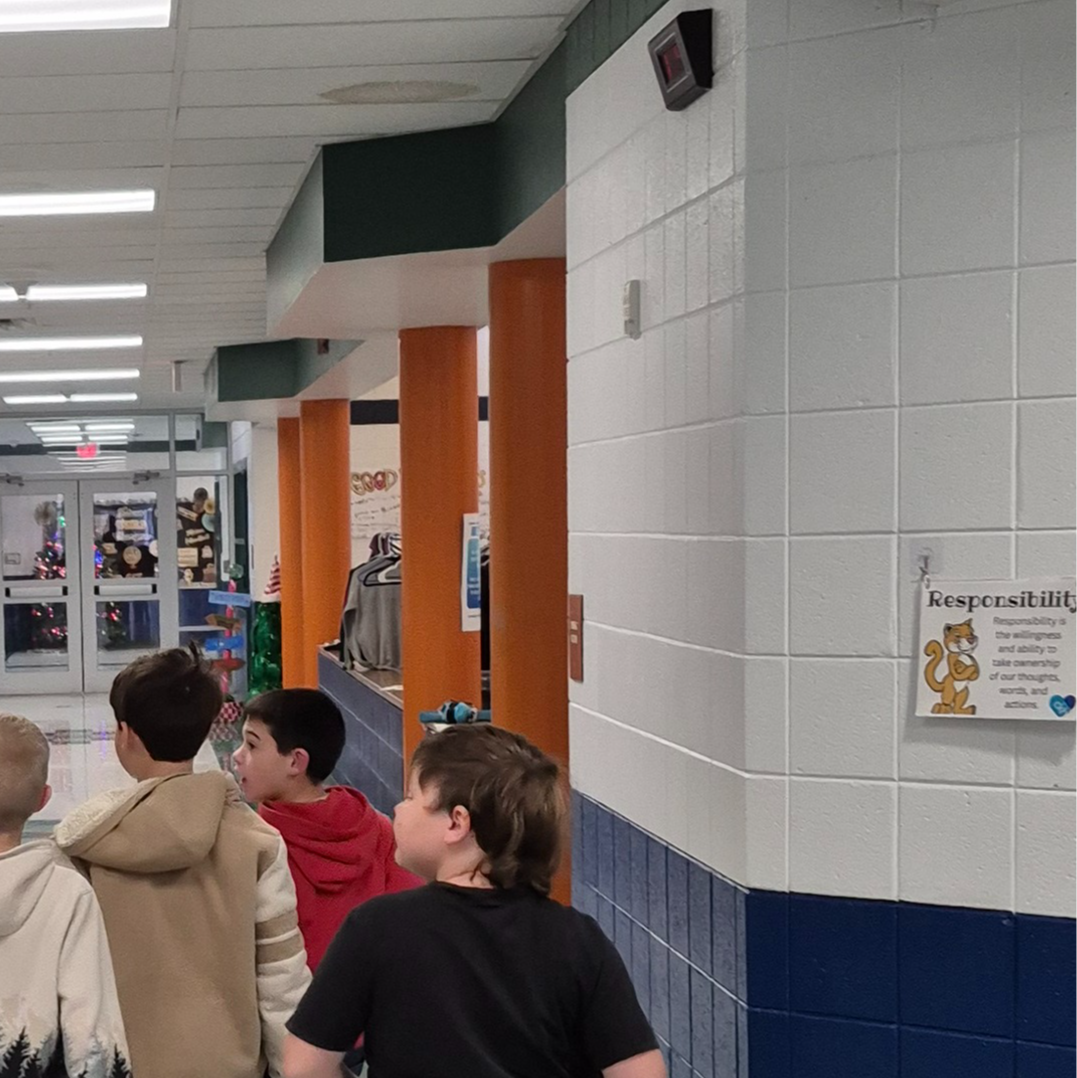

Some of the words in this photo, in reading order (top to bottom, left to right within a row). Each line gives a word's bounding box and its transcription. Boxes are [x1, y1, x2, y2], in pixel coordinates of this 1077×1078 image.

[993, 617, 1056, 627] Responsibility
[995, 631, 1011, 639] the
[1013, 630, 1062, 641] willingness
[998, 645, 1015, 653] and
[1017, 645, 1044, 655] ability
[992, 659, 1012, 667] take
[1013, 659, 1061, 669] ownership
[989, 672, 999, 680] of
[1031, 687, 1048, 695] and
